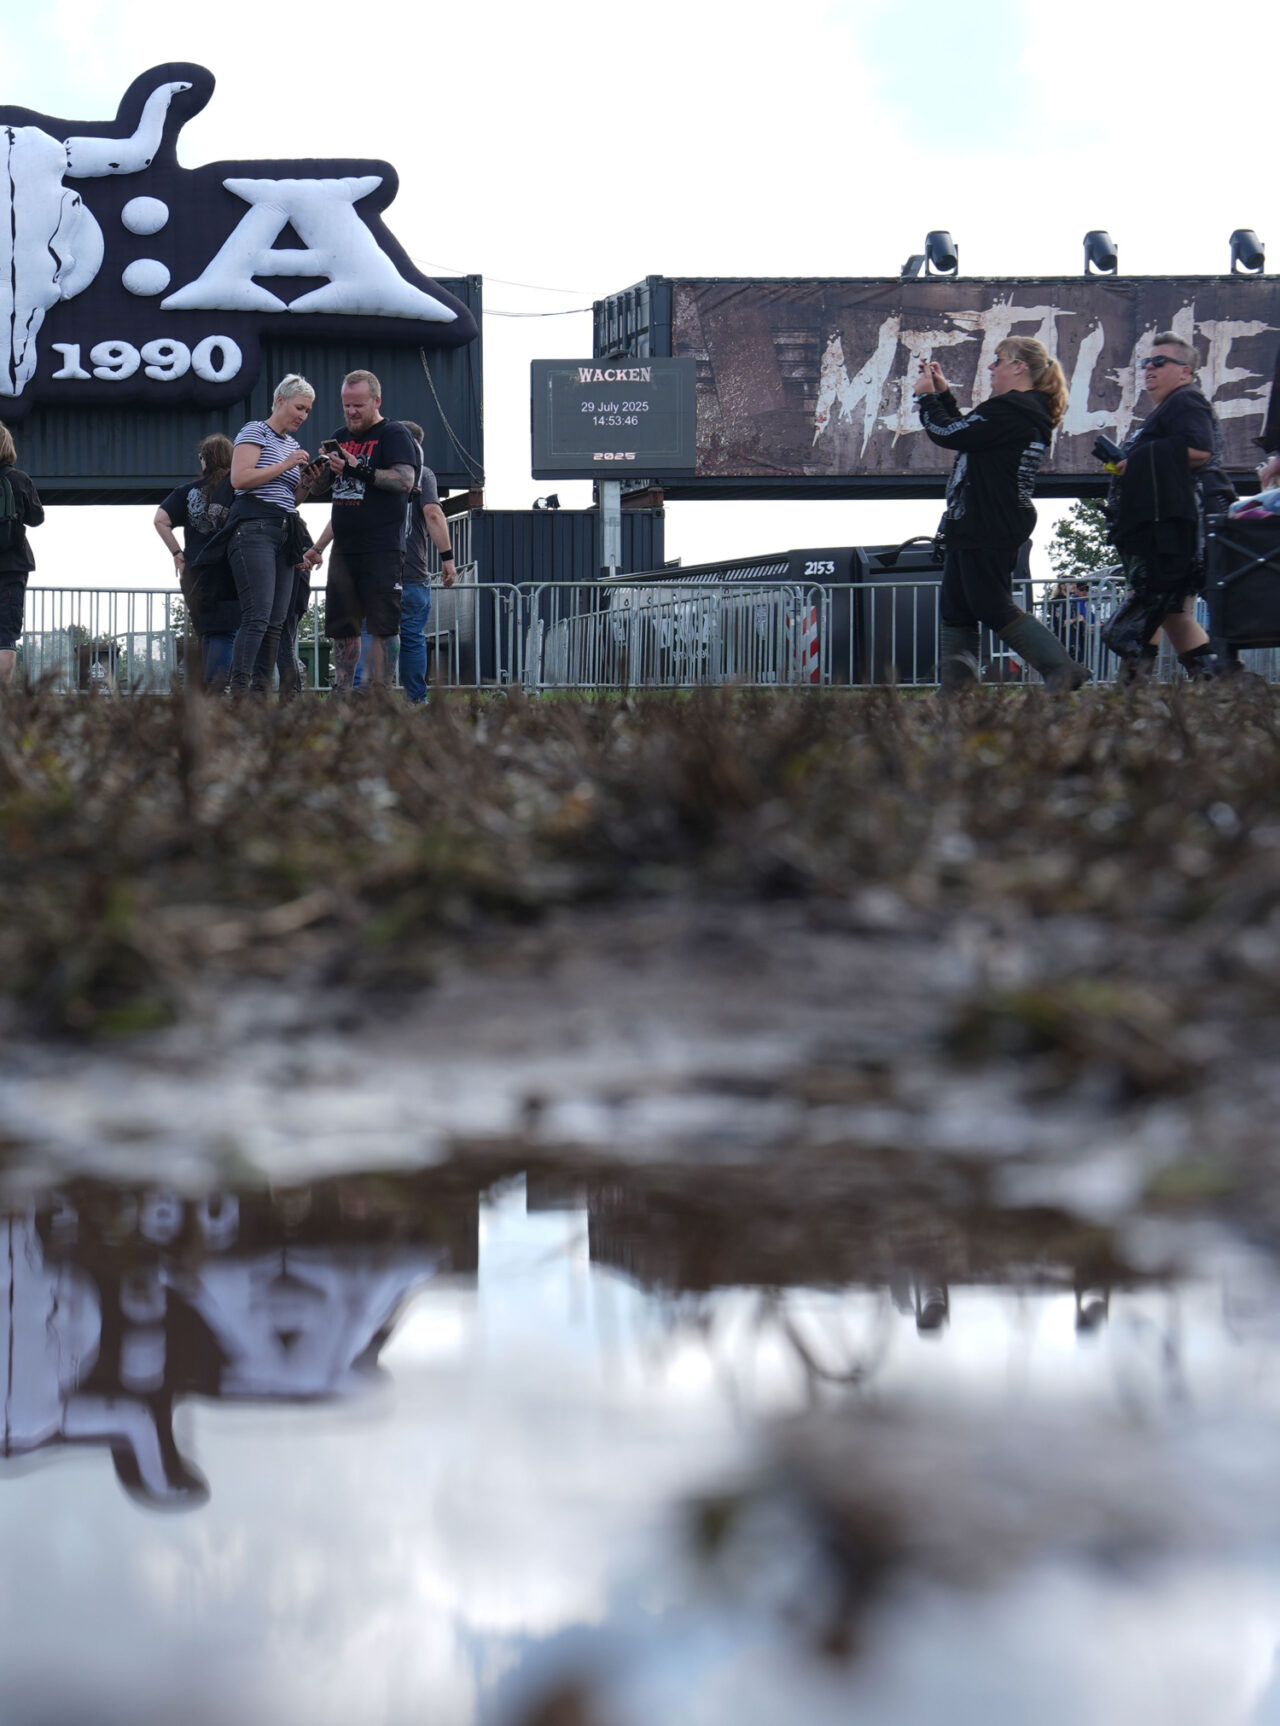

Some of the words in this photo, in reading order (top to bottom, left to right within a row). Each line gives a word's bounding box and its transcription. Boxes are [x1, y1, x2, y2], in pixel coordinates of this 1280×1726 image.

[51, 335, 242, 382] 1990
[578, 366, 652, 383] WACKEN
[581, 402, 595, 412] 29
[598, 401, 619, 414] July
[622, 401, 649, 412] 2025
[592, 416, 638, 425] 14:53:46
[593, 452, 636, 460] 2025
[804, 560, 835, 575] 2153
